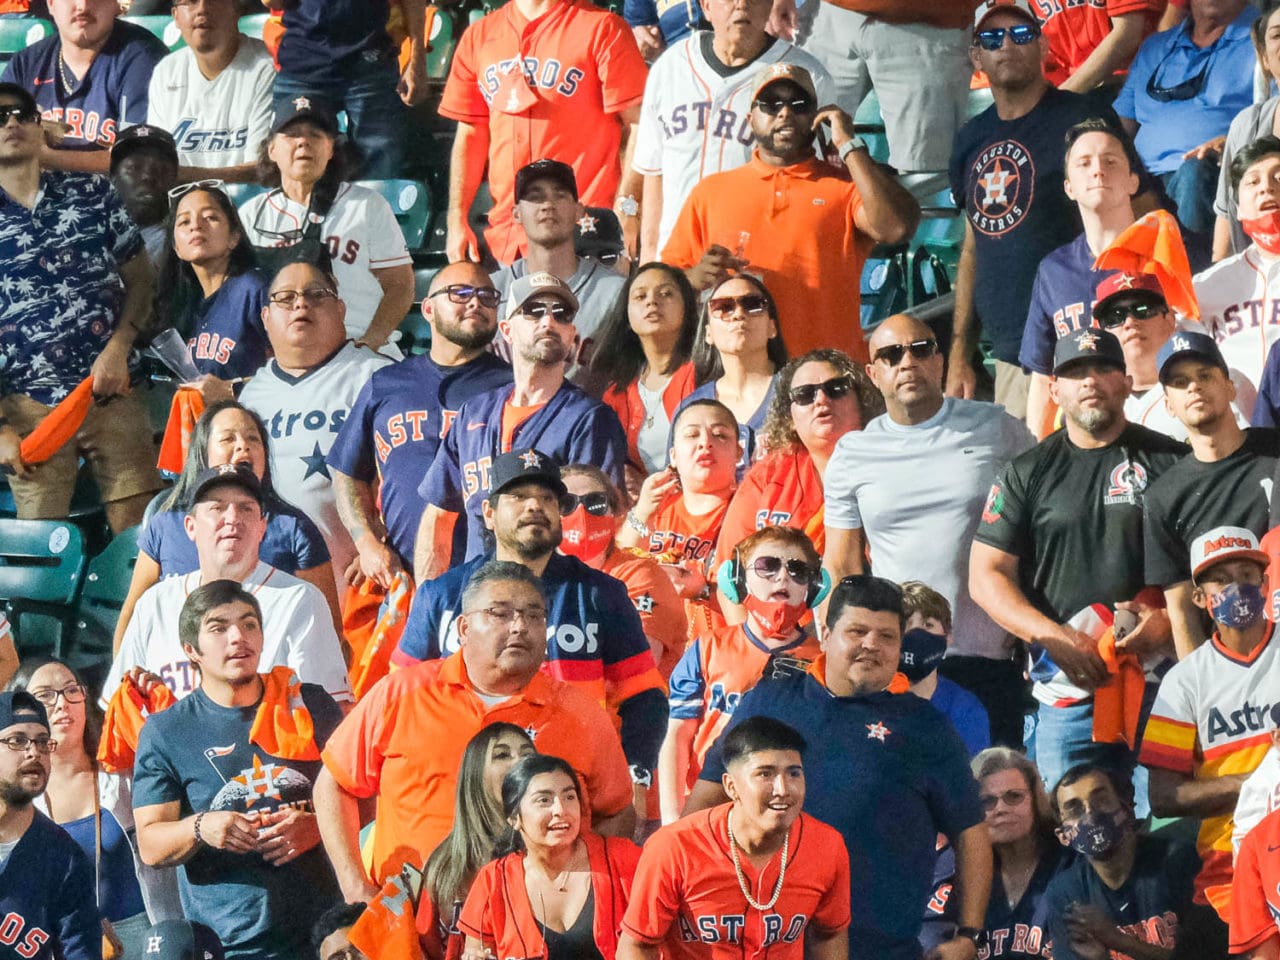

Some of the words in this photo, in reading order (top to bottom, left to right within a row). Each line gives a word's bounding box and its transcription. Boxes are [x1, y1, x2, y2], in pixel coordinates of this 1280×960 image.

[975, 143, 1028, 172] HOUSTON
[973, 205, 1023, 231] ASTROS
[1172, 335, 1191, 351] LA
[264, 408, 347, 439] tros
[462, 456, 492, 501] ST
[1203, 537, 1252, 556] Astros
[1208, 700, 1270, 743] Astr
[0, 912, 50, 959] OS
[146, 935, 163, 954] H
